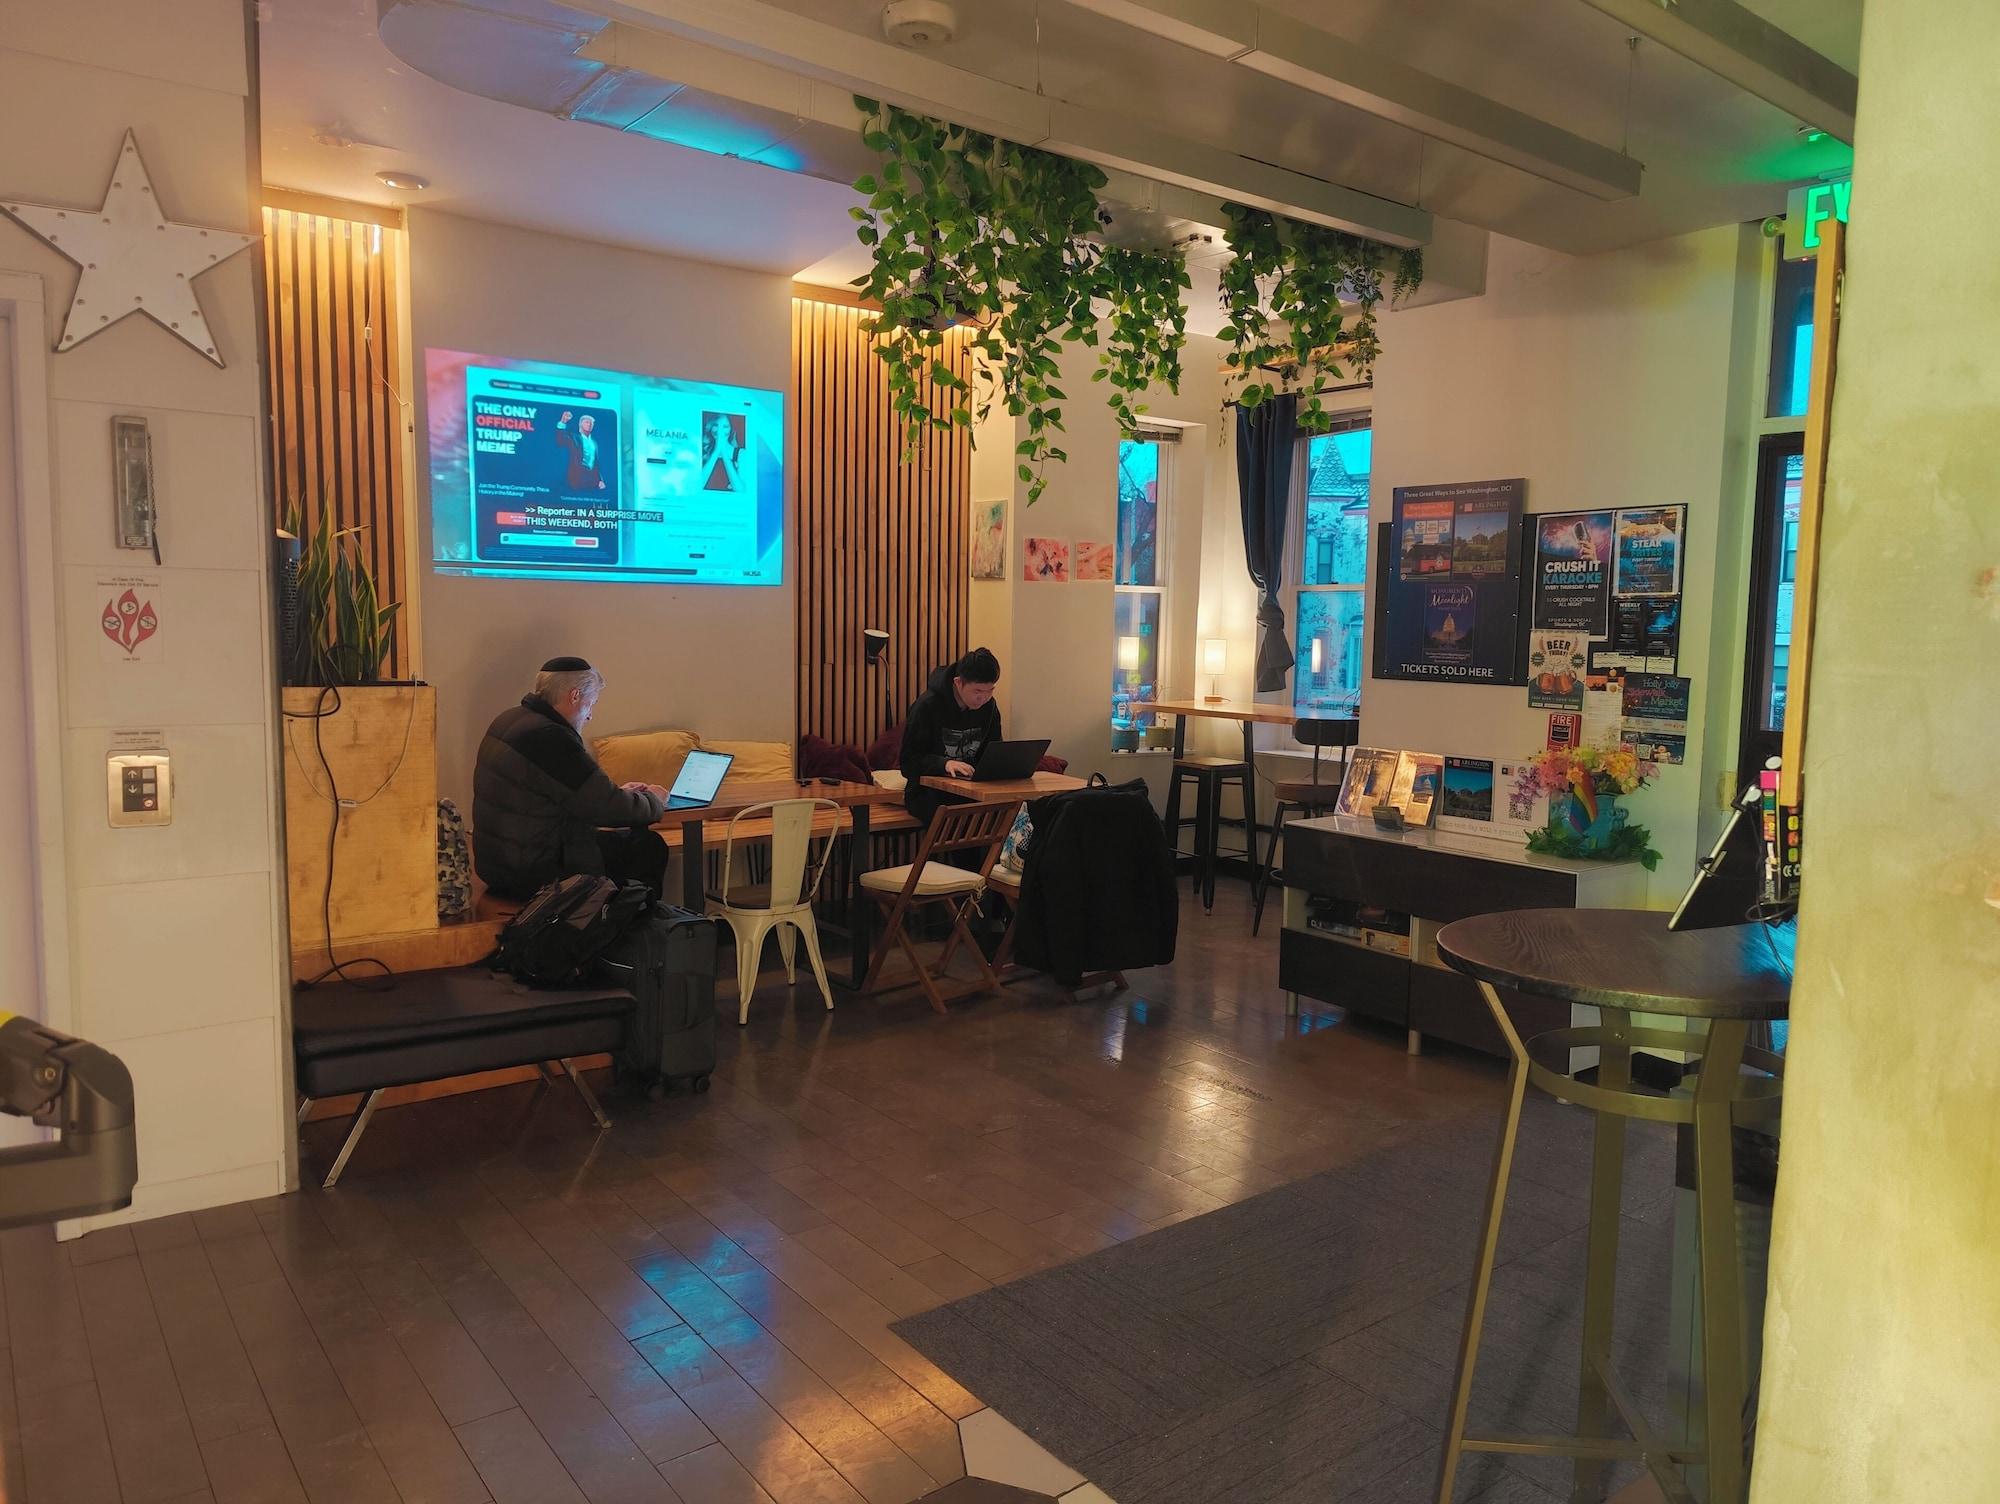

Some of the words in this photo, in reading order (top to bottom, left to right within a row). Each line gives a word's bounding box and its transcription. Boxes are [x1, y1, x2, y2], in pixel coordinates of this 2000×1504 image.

[475, 402, 502, 416] THE
[503, 405, 537, 419] ONLY
[476, 415, 535, 431] OFFICIAL
[476, 428, 522, 442] TRUMP
[646, 428, 688, 440] MELANIA
[477, 441, 516, 455] MEME
[537, 506, 576, 518] Reporter:
[577, 508, 587, 518] IN
[587, 509, 595, 518] A
[596, 510, 637, 520] SURPRISE
[638, 512, 663, 522] MOVE
[526, 517, 546, 526] THIS
[548, 518, 592, 530] WEEKEND,
[594, 521, 618, 530] BOTH
[1632, 539, 1662, 548] STEAK
[1545, 561, 1586, 573] CRUSH
[1588, 560, 1601, 572] IT
[1543, 572, 1602, 585] KARAOKE
[1546, 639, 1571, 651] BEER
[1401, 663, 1440, 674] TICKETS
[1441, 666, 1467, 676] SOLD
[1468, 668, 1494, 678] HERE
[1551, 714, 1573, 725] FIRE
